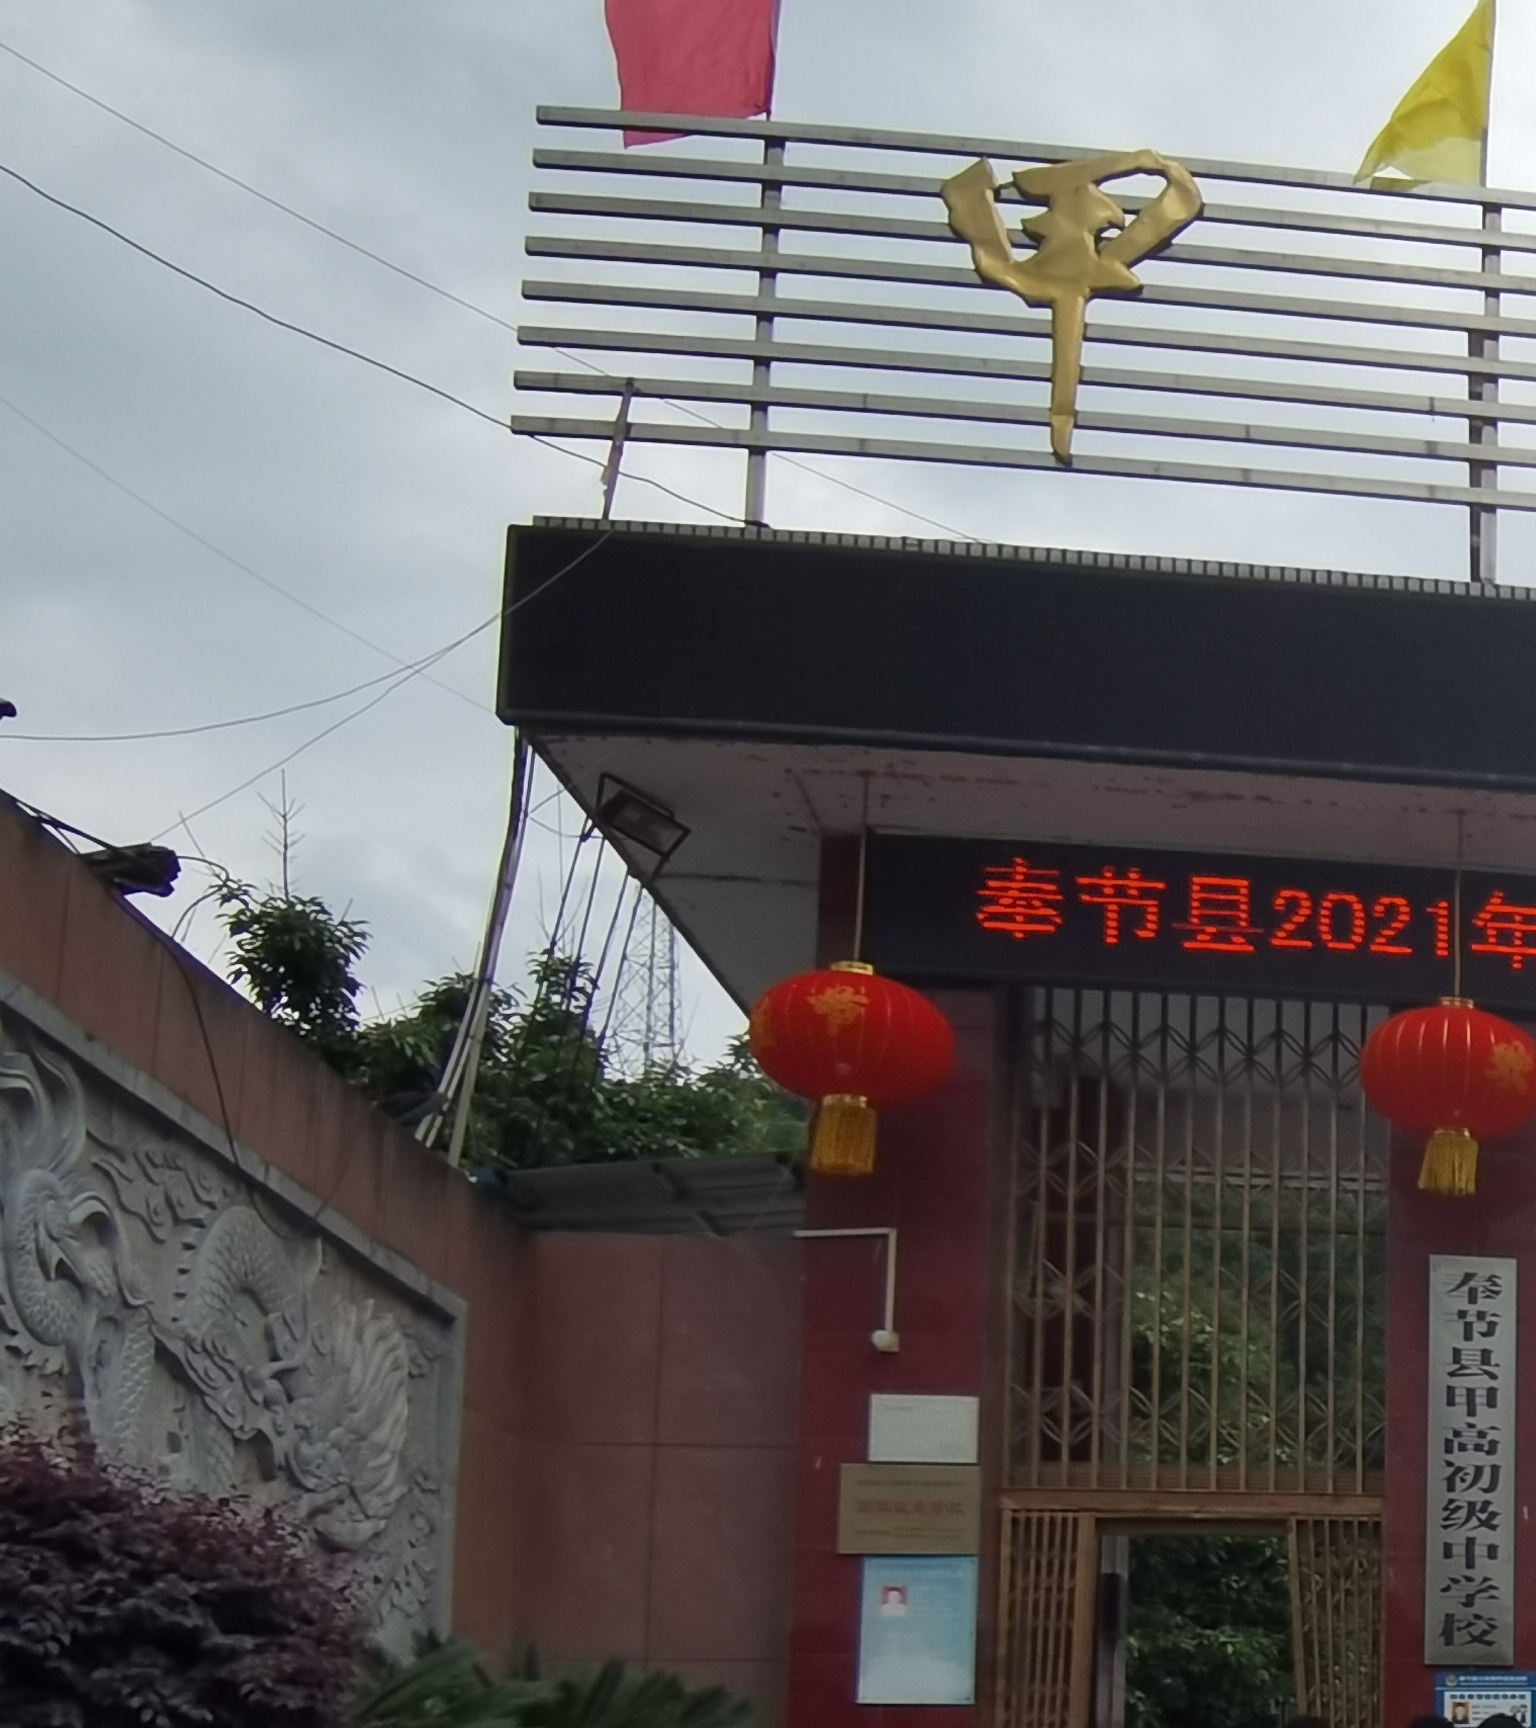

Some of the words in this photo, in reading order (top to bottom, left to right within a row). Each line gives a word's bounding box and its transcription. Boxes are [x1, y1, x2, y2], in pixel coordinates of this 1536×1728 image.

[1438, 1270, 1503, 1649] 奉节县甲高初级中学校
